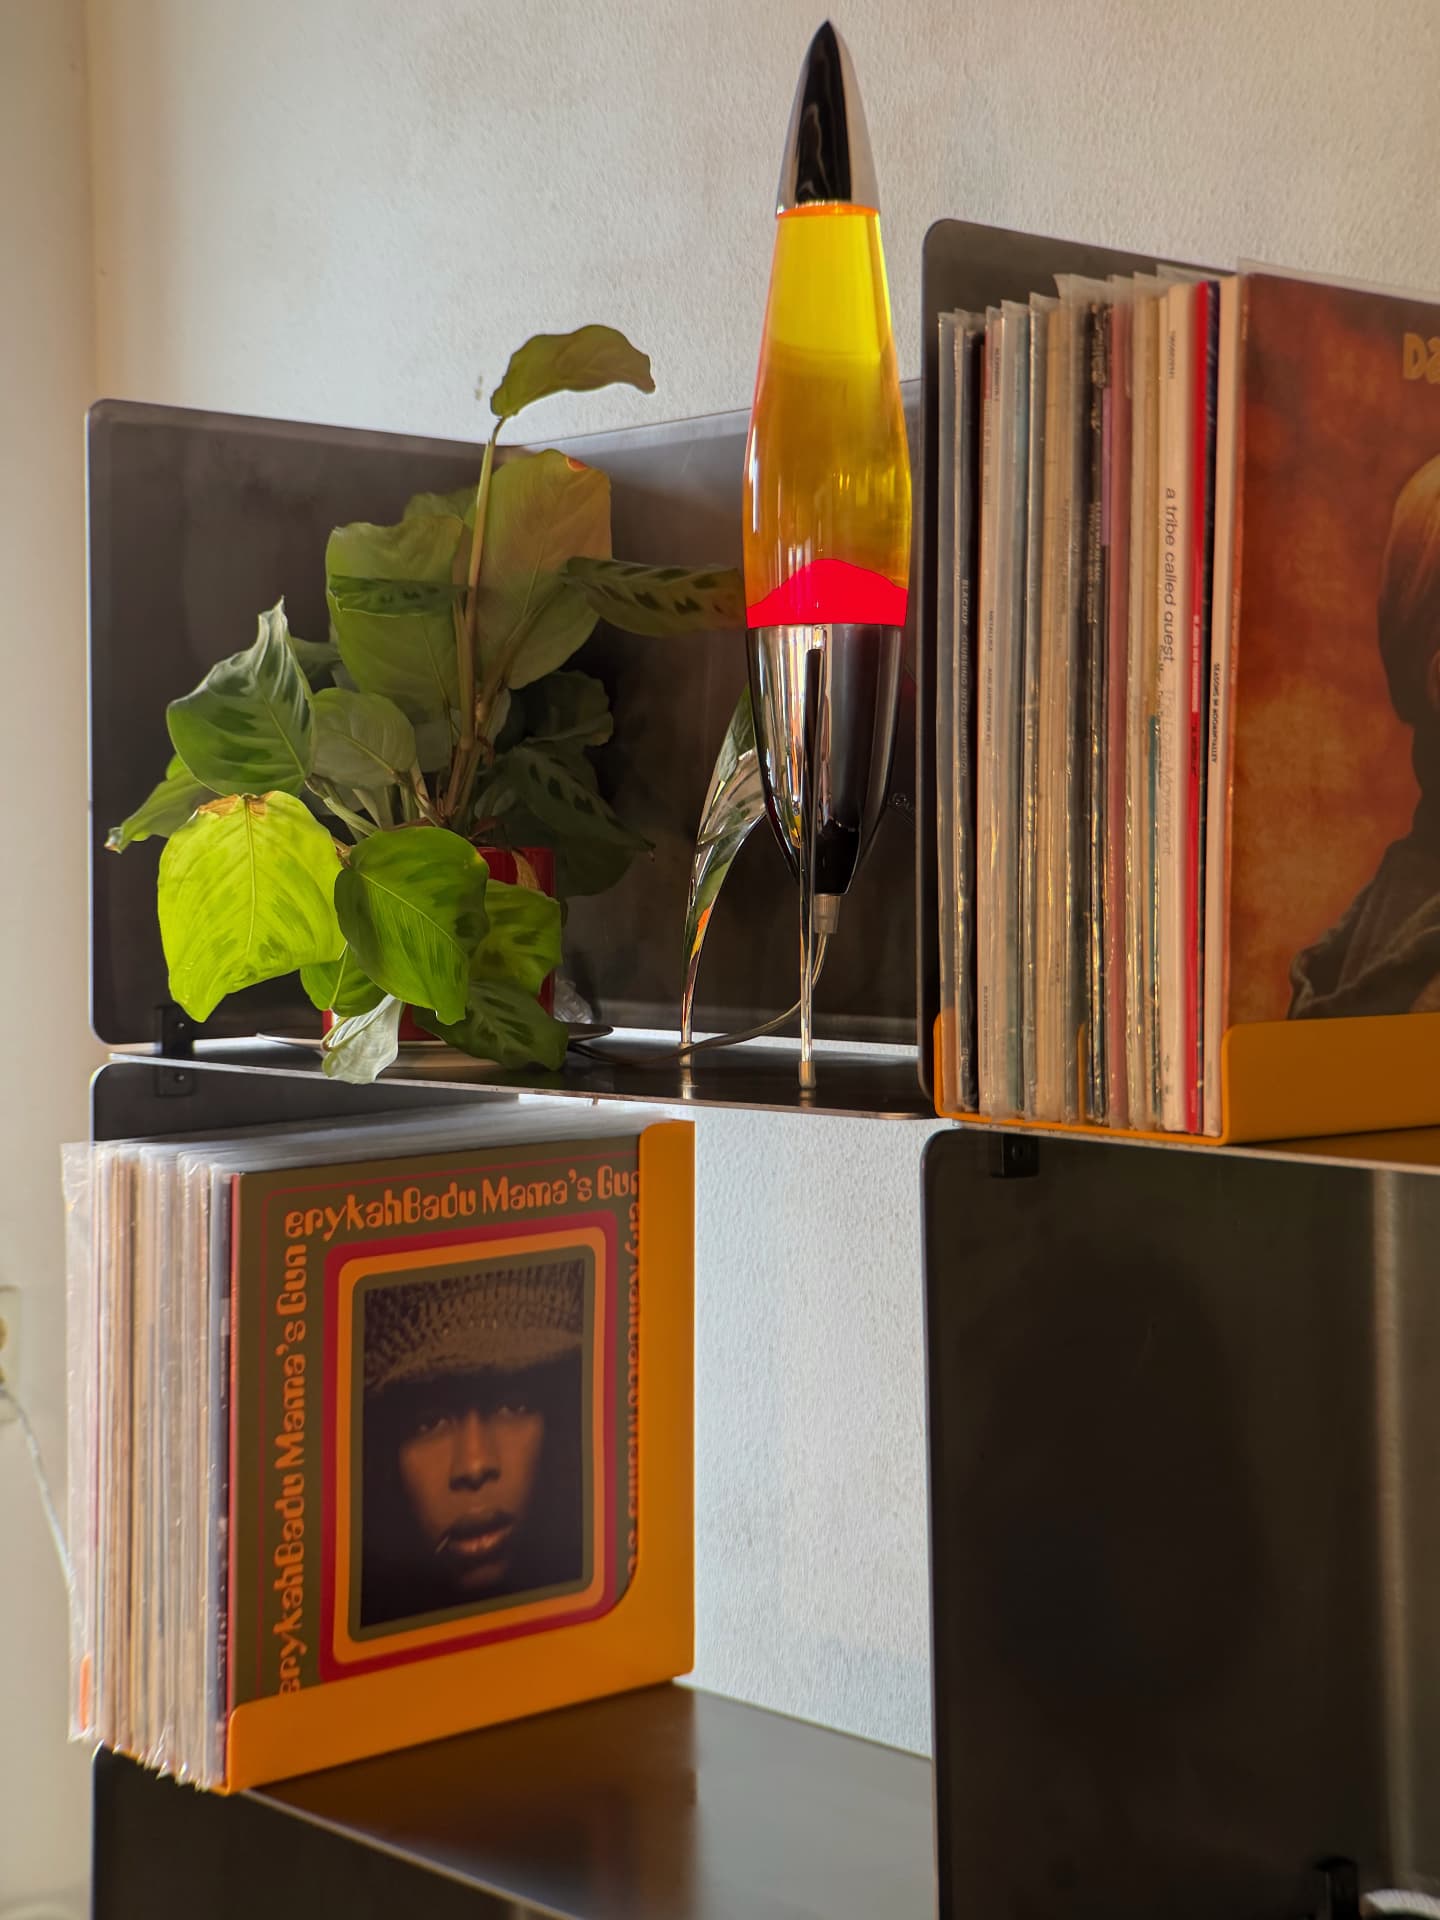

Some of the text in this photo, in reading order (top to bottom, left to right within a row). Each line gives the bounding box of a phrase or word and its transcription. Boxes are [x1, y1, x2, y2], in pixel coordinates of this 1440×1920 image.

[1163, 487, 1179, 662] a tribe called quest
[481, 1166, 593, 1217] Mama's
[276, 1243, 307, 1317] Gun
[274, 1319, 306, 1470] Mama's
